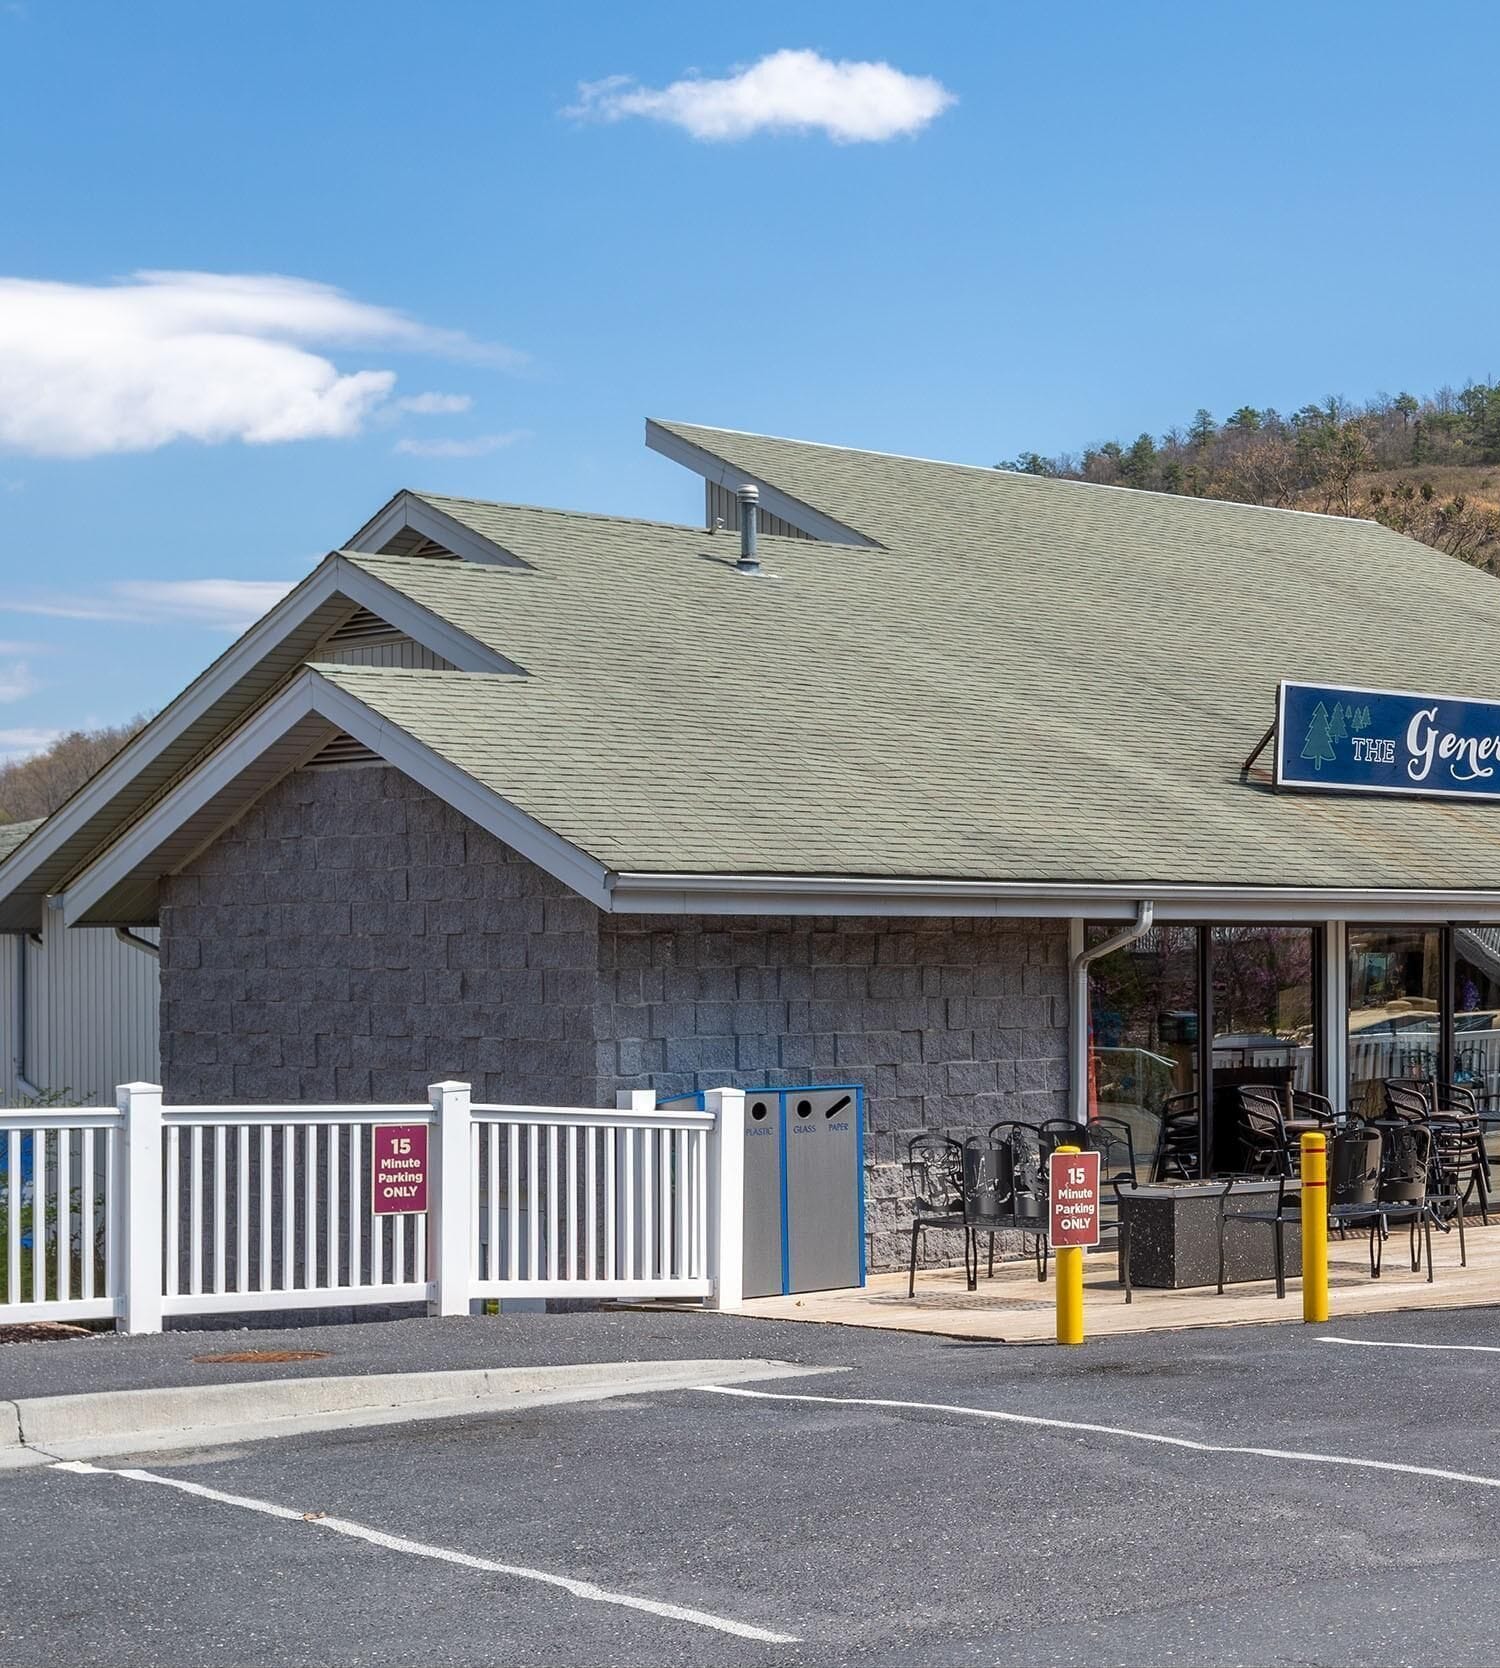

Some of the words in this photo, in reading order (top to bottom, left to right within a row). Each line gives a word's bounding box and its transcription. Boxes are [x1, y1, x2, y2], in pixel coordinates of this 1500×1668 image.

[1351, 737, 1396, 763] THE
[745, 1127, 774, 1136] PLASTIC
[793, 1124, 817, 1134] GLASS
[828, 1122, 849, 1132] PAPER
[390, 1138, 411, 1155] 15
[381, 1158, 421, 1169] Minute
[378, 1171, 423, 1183] Parking
[1067, 1167, 1086, 1185] 15
[383, 1186, 418, 1198] ONLY
[1058, 1188, 1093, 1200] Minute
[1055, 1203, 1095, 1215] Parking
[1061, 1217, 1091, 1230] ONLY
